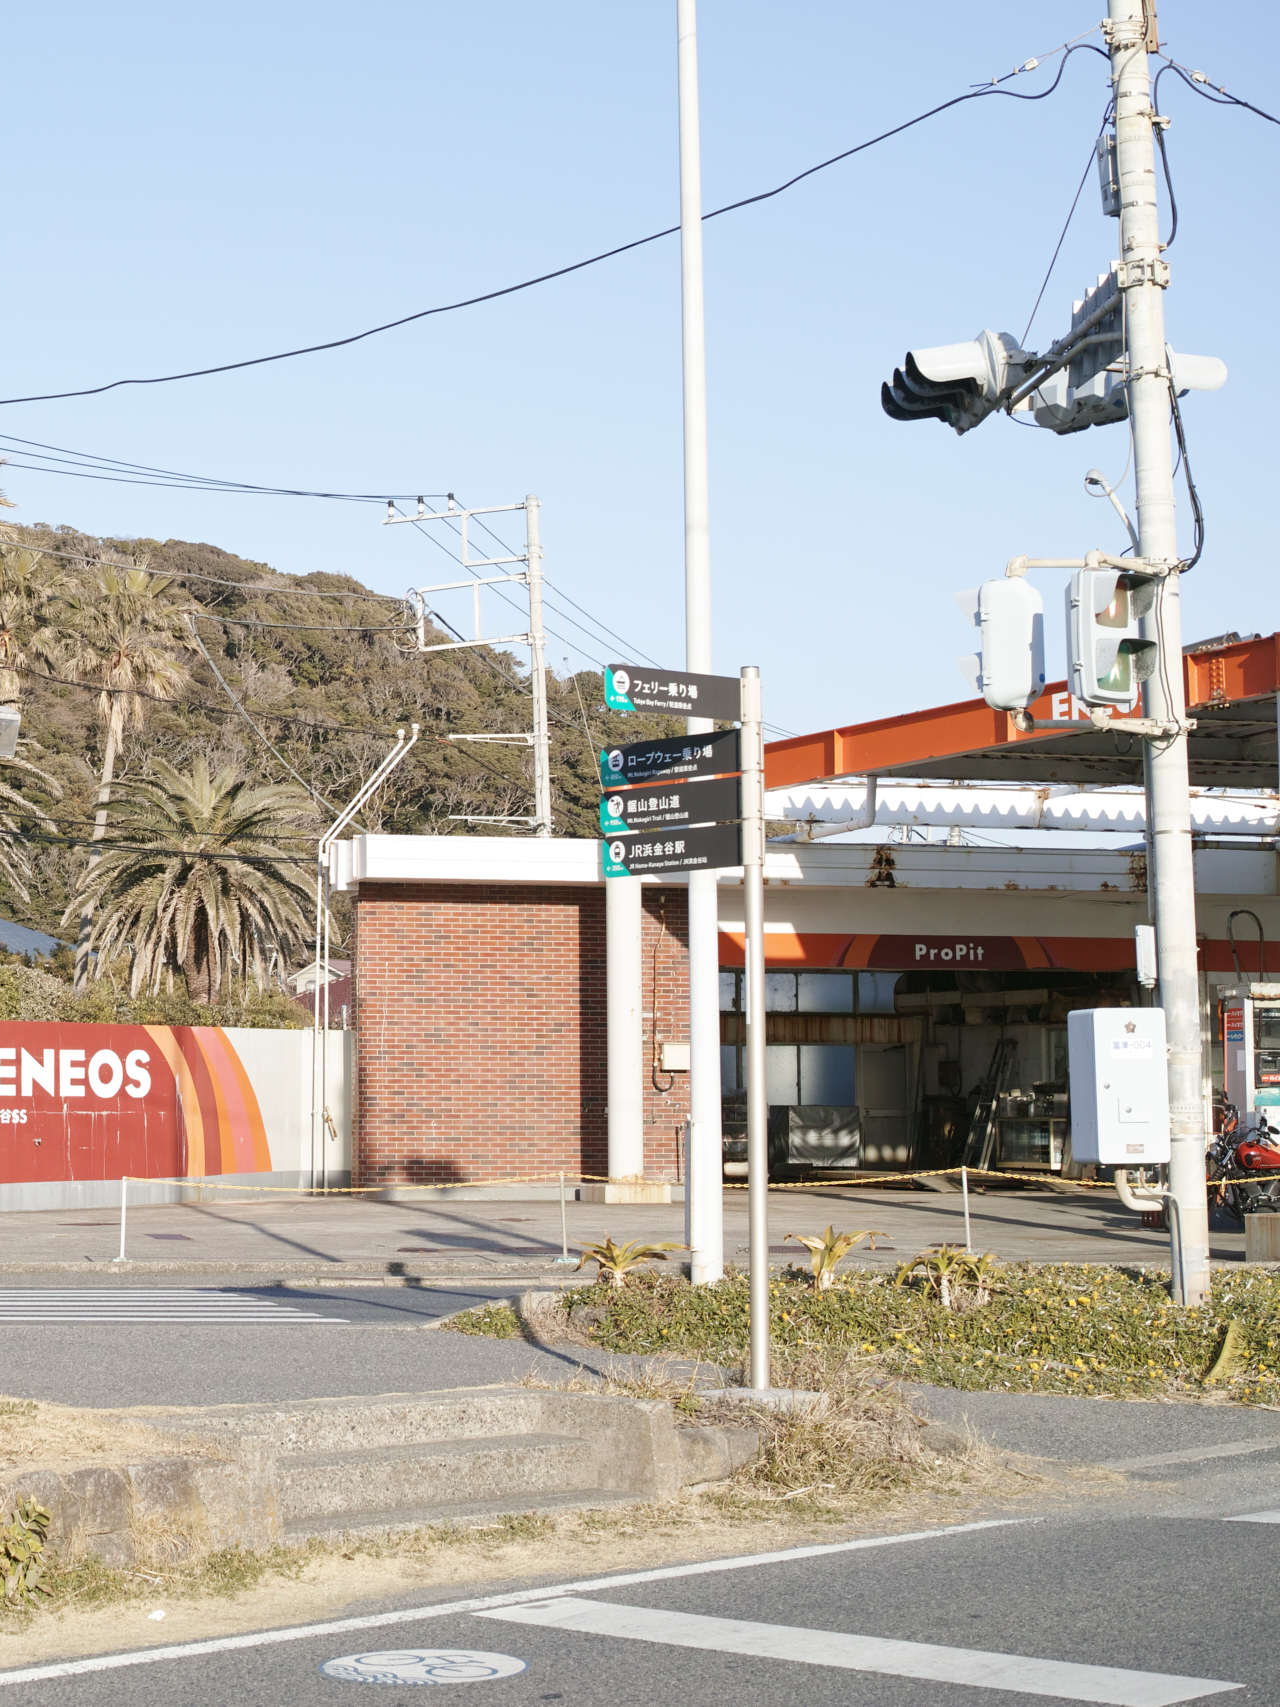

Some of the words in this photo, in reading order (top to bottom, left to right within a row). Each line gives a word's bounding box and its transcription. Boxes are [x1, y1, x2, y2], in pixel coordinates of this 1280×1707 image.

[633, 680, 698, 699] フェリー乗り場
[633, 697, 645, 705] Tokyo
[646, 698, 654, 706] Bay
[654, 700, 666, 708] Ferry
[627, 744, 713, 767] ロープウェー乗り場
[651, 768, 671, 776] Ropeway
[626, 794, 680, 813] 鋸山登山道
[628, 840, 685, 858] JR浜金谷駅
[634, 861, 664, 869] Hama-Kanaya
[664, 858, 680, 867] Station
[914, 943, 984, 961] ProPit
